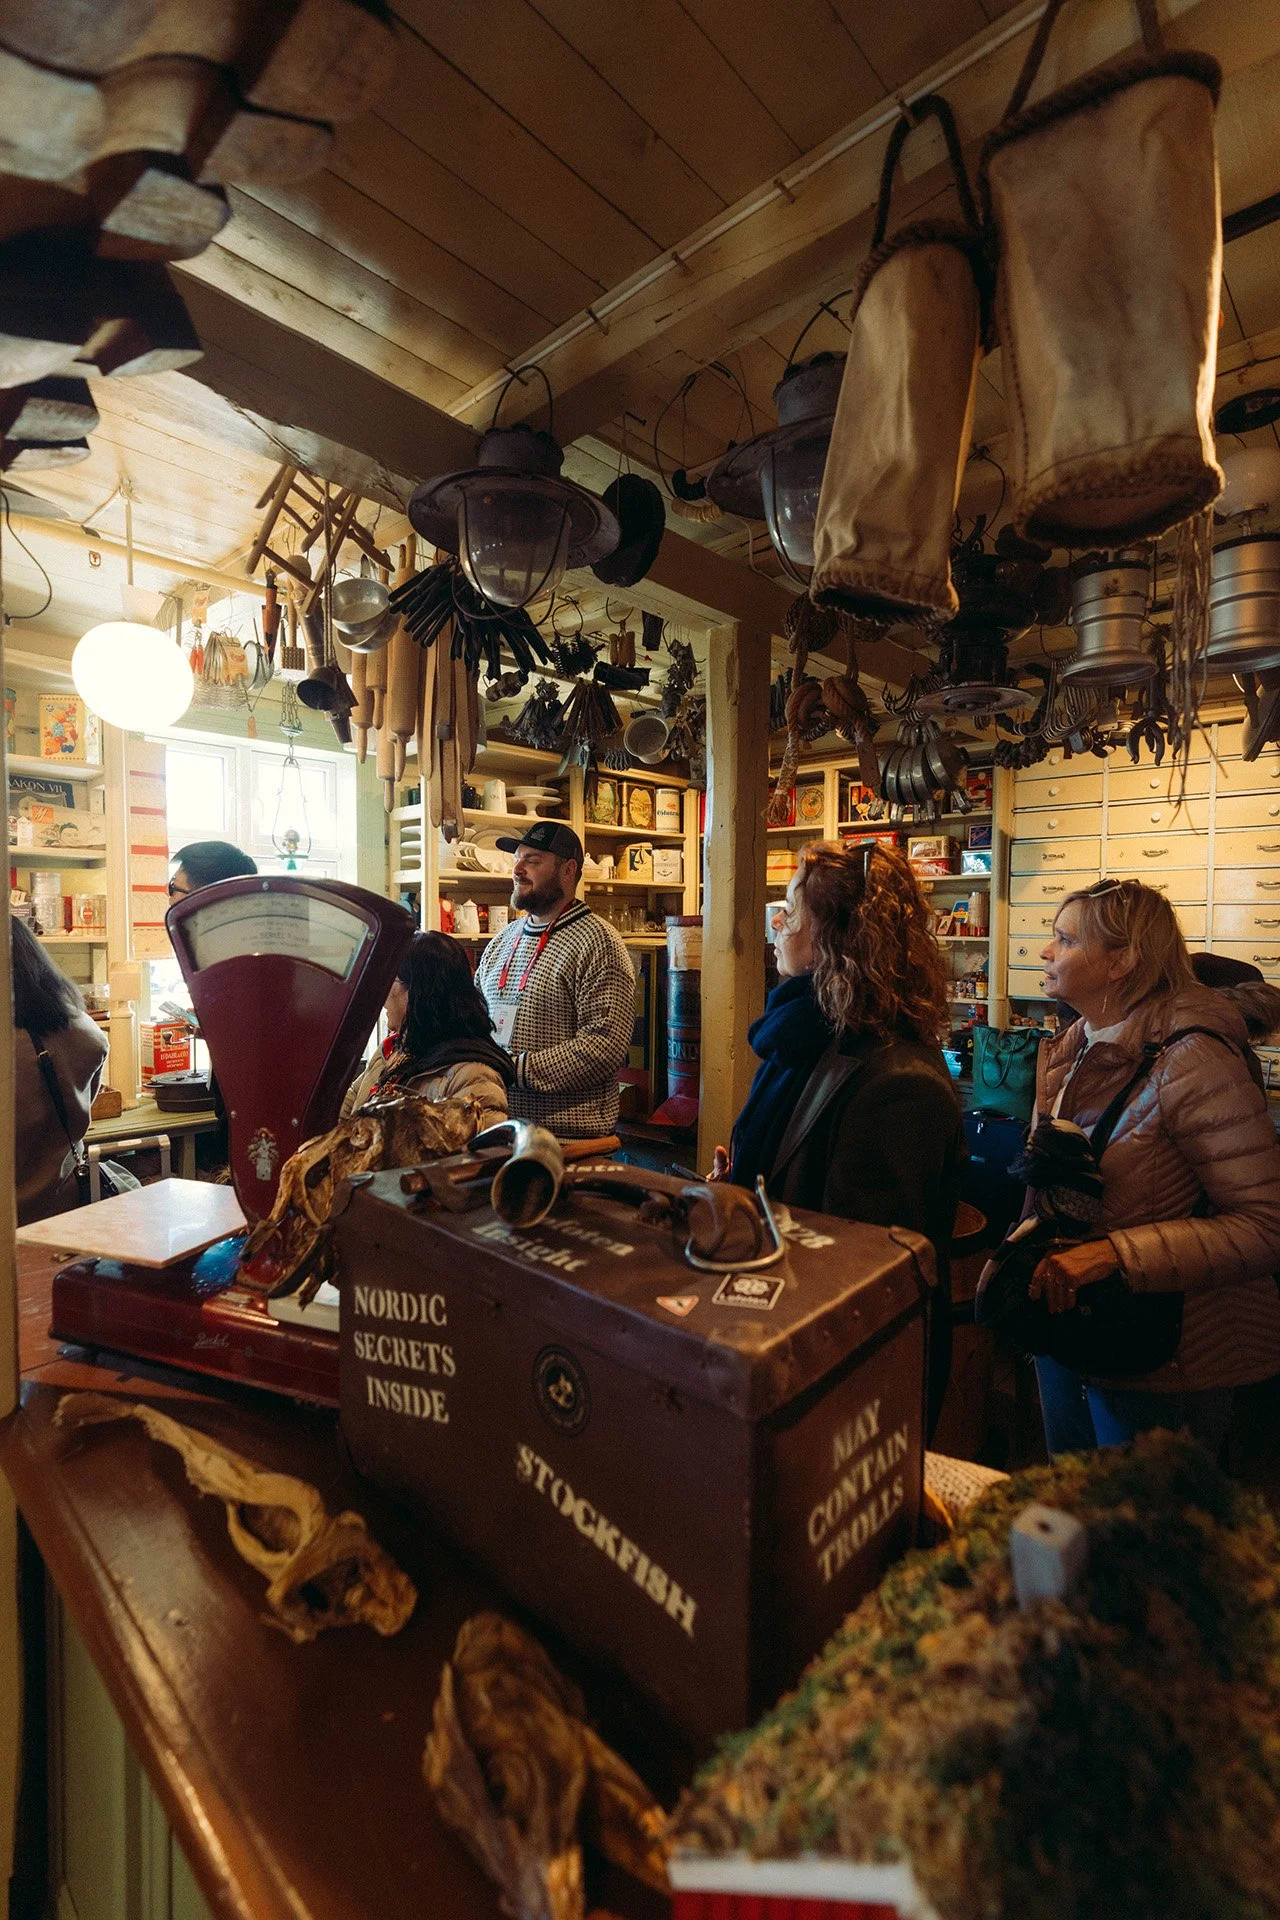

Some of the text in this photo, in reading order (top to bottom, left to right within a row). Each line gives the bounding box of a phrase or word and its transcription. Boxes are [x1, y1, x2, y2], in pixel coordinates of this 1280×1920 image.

[354, 1285, 448, 1327] NORDIC
[353, 1330, 457, 1378] SECRETS
[366, 1374, 449, 1425] INSIDE
[832, 1398, 881, 1473] MAY
[808, 1421, 909, 1546] CONTAIN
[516, 1442, 698, 1638] STOCKFISH
[816, 1473, 904, 1585] TROLLS
